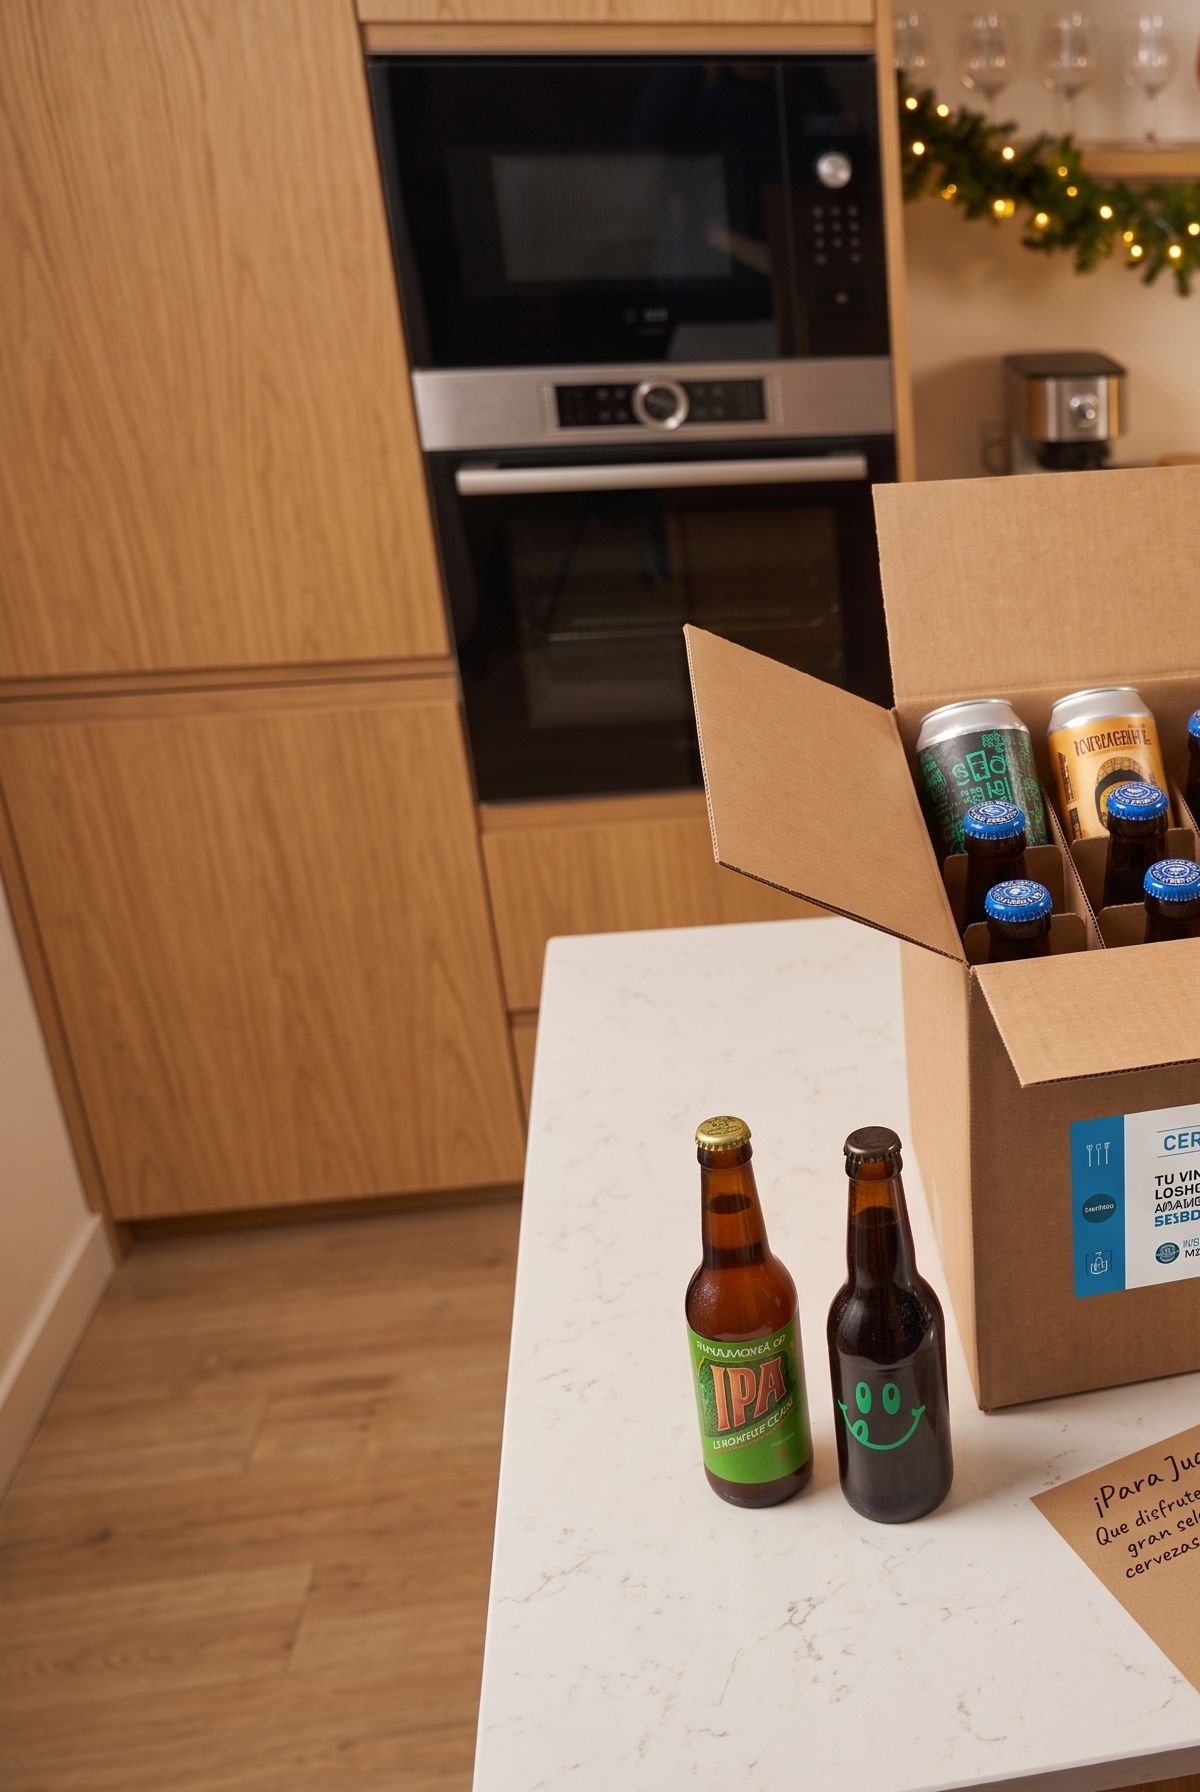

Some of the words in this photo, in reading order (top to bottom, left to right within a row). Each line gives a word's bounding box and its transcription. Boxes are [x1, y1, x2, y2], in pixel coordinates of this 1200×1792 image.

[1154, 1173, 1175, 1186] TU
[709, 1355, 787, 1432] IPA
[1094, 1474, 1164, 1518] ¡Para
[1096, 1524, 1130, 1546] Que
[1127, 1529, 1172, 1558] gran
[1125, 1537, 1200, 1579] cervezas
